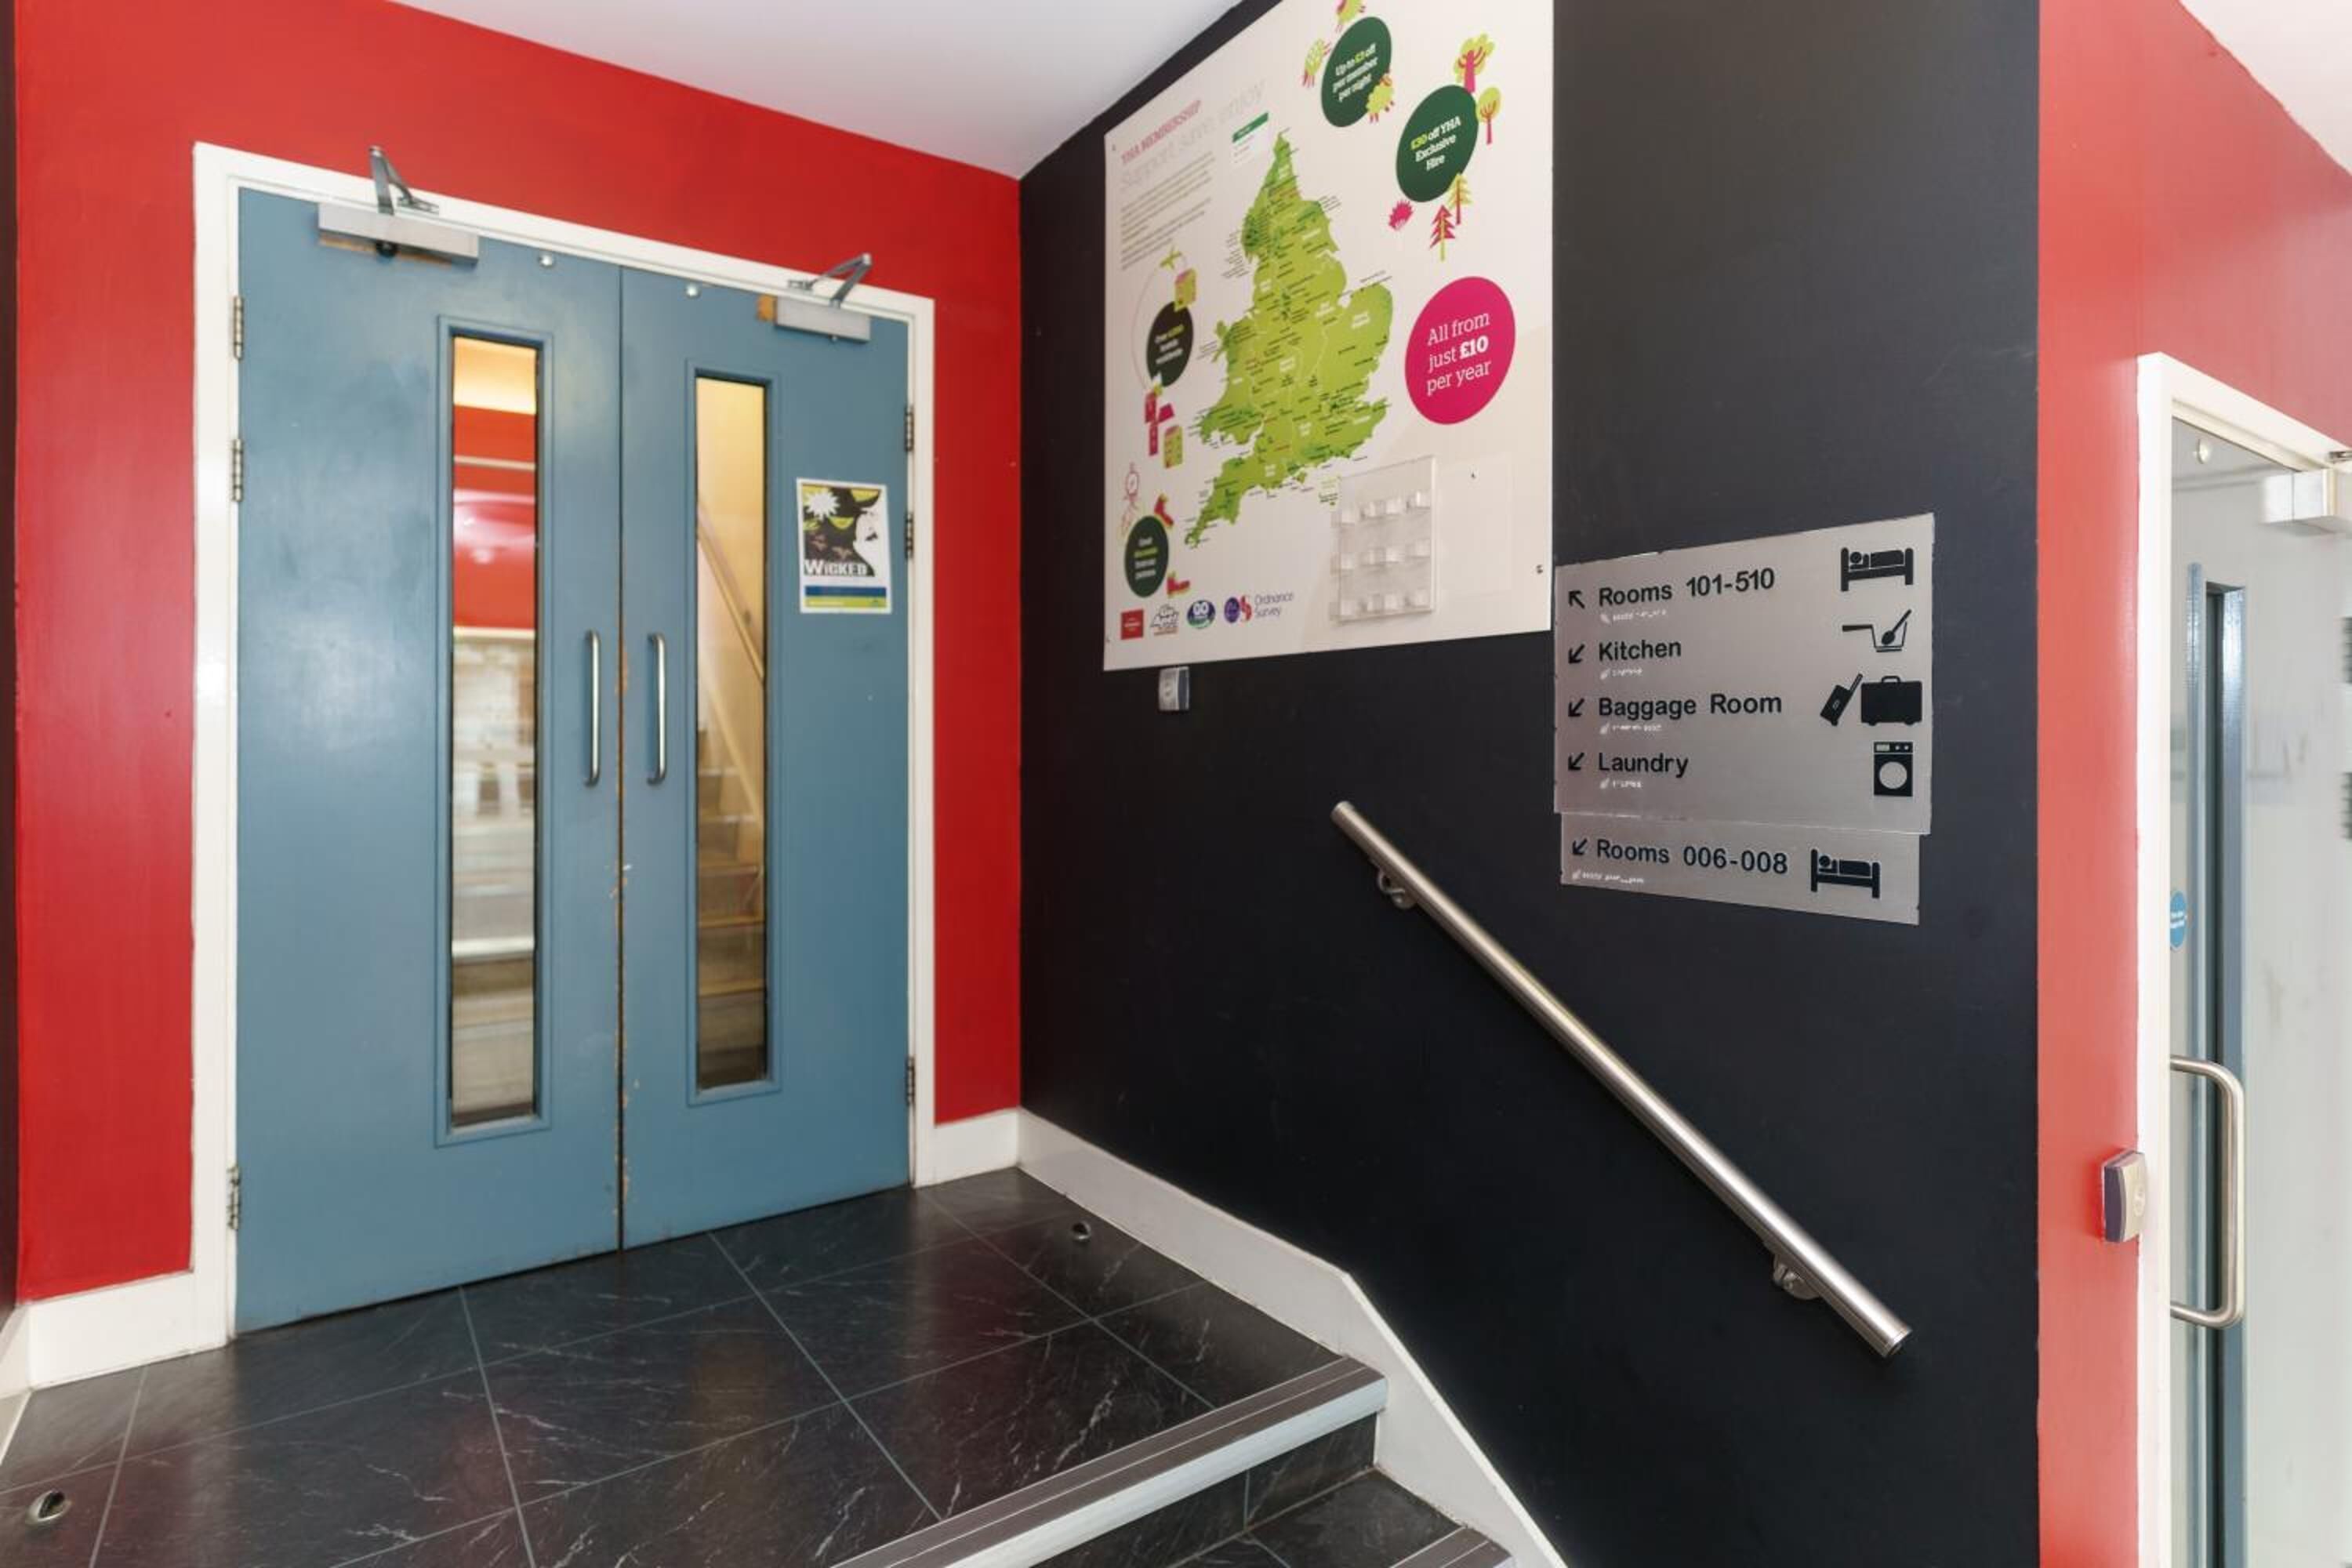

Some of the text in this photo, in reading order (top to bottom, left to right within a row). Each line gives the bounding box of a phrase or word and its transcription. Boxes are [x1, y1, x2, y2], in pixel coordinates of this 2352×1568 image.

[1440, 115, 1461, 134] YHA
[1428, 313, 1490, 347] All from
[1428, 335, 1489, 374] just £10
[1427, 361, 1491, 397] per year
[1599, 568, 1774, 607] Rooms 101-510
[1599, 639, 1682, 662] Kitchen
[1599, 693, 1782, 721] Baggage Room
[1598, 752, 1689, 779] Laundry
[1596, 838, 1788, 875] Rooms 006-008
